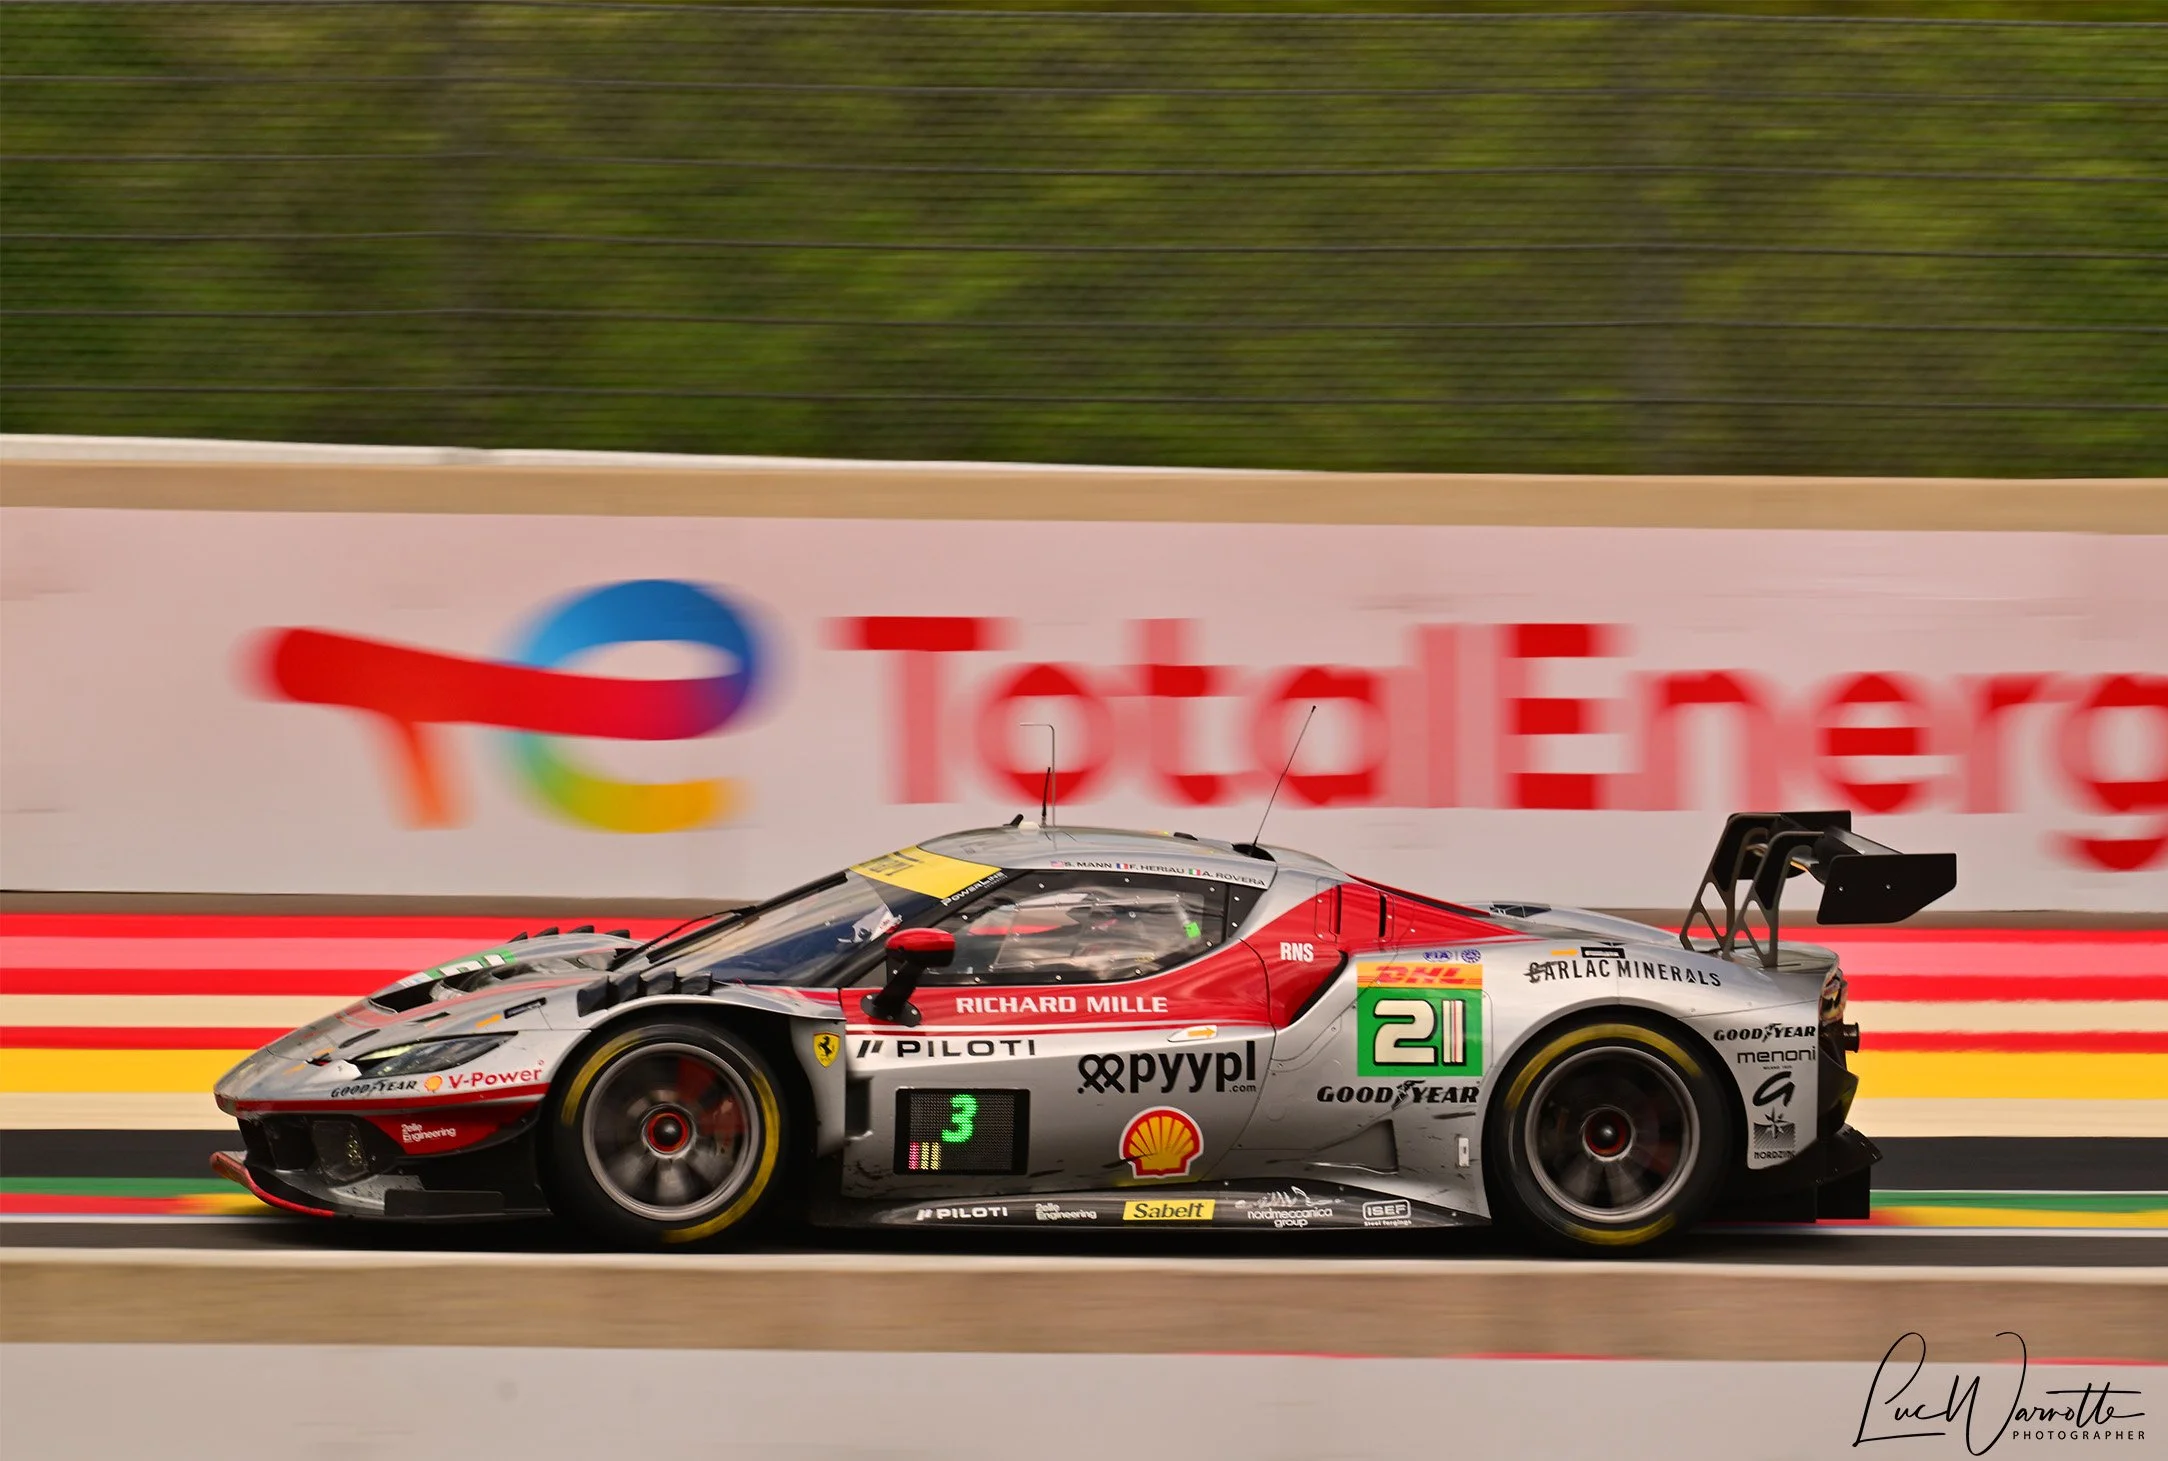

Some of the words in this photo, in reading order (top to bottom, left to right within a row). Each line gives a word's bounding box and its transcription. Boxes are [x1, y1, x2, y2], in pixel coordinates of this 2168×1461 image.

[1077, 861, 1112, 869] MANN
[1140, 864, 1185, 874] HERIAU
[1216, 873, 1266, 886] ROVERA
[1280, 941, 1314, 963] RNS
[1425, 951, 1454, 960] FIA
[1376, 966, 1465, 985] DHL
[1617, 959, 1722, 987] MINERALS
[956, 997, 1077, 1014] RICHARD
[1087, 996, 1169, 1013] MILLE
[1373, 998, 1467, 1066] 21
[896, 1039, 1036, 1057] PILOTI
[1737, 1045, 1816, 1064] menoni
[1129, 1040, 1256, 1094] pyypl
[449, 1067, 543, 1089] V-Power
[941, 1094, 979, 1143] 3
[935, 1206, 1009, 1219] PILOTI
[1133, 1202, 1205, 1219] Sabelt
[1247, 1207, 1333, 1219] nordmeccanica
[1367, 1204, 1407, 1217] ISEF
[1274, 1218, 1309, 1228] group
